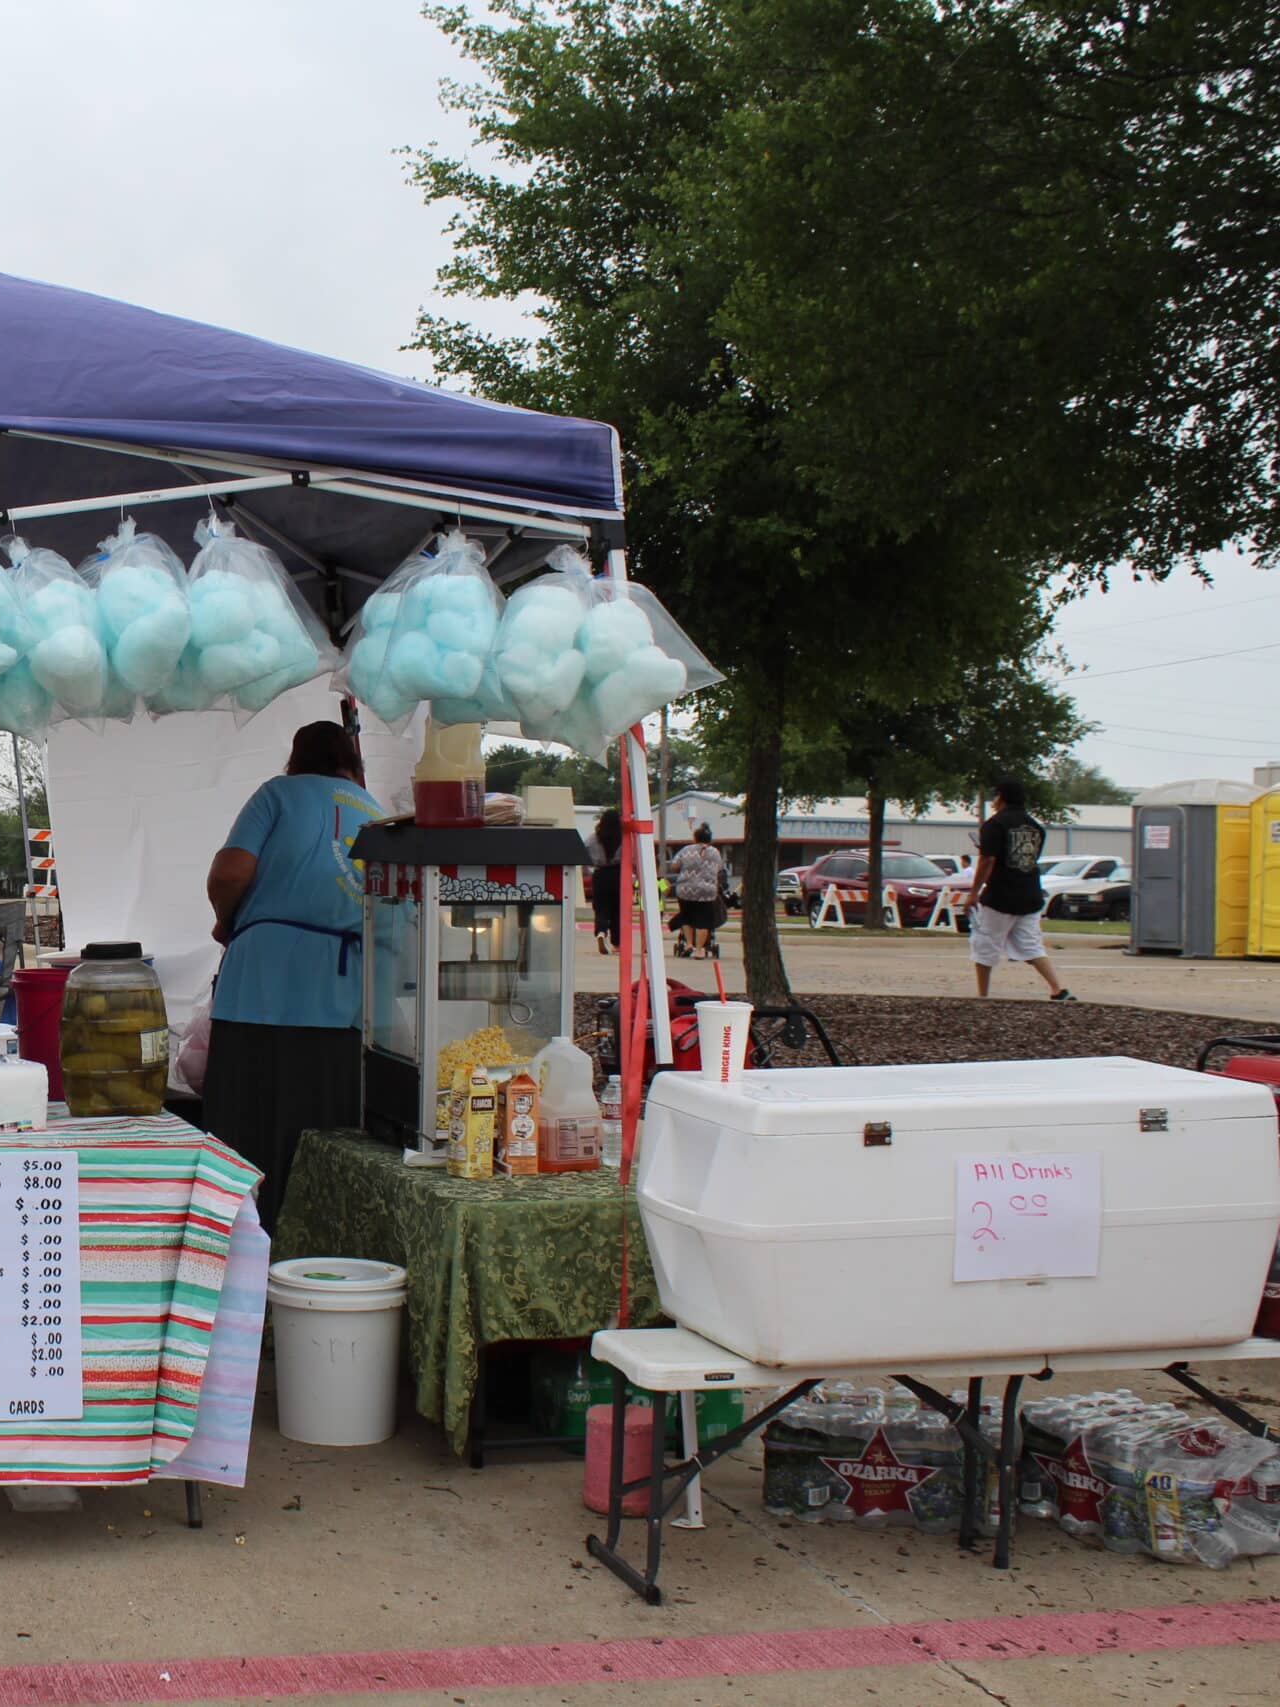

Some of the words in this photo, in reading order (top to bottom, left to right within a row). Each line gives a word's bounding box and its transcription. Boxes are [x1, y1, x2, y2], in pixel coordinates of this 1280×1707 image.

[723, 1025, 732, 1047] KING
[23, 1160, 62, 1171] $5.00
[974, 1163, 1004, 1181] All
[1011, 1162, 1073, 1180] Drinks
[24, 1176, 62, 1190] $8.00
[21, 1315, 62, 1327] $2.00
[31, 1348, 62, 1362] $2.00
[9, 1400, 45, 1415] CARDS
[838, 1462, 919, 1484] OZARKA
